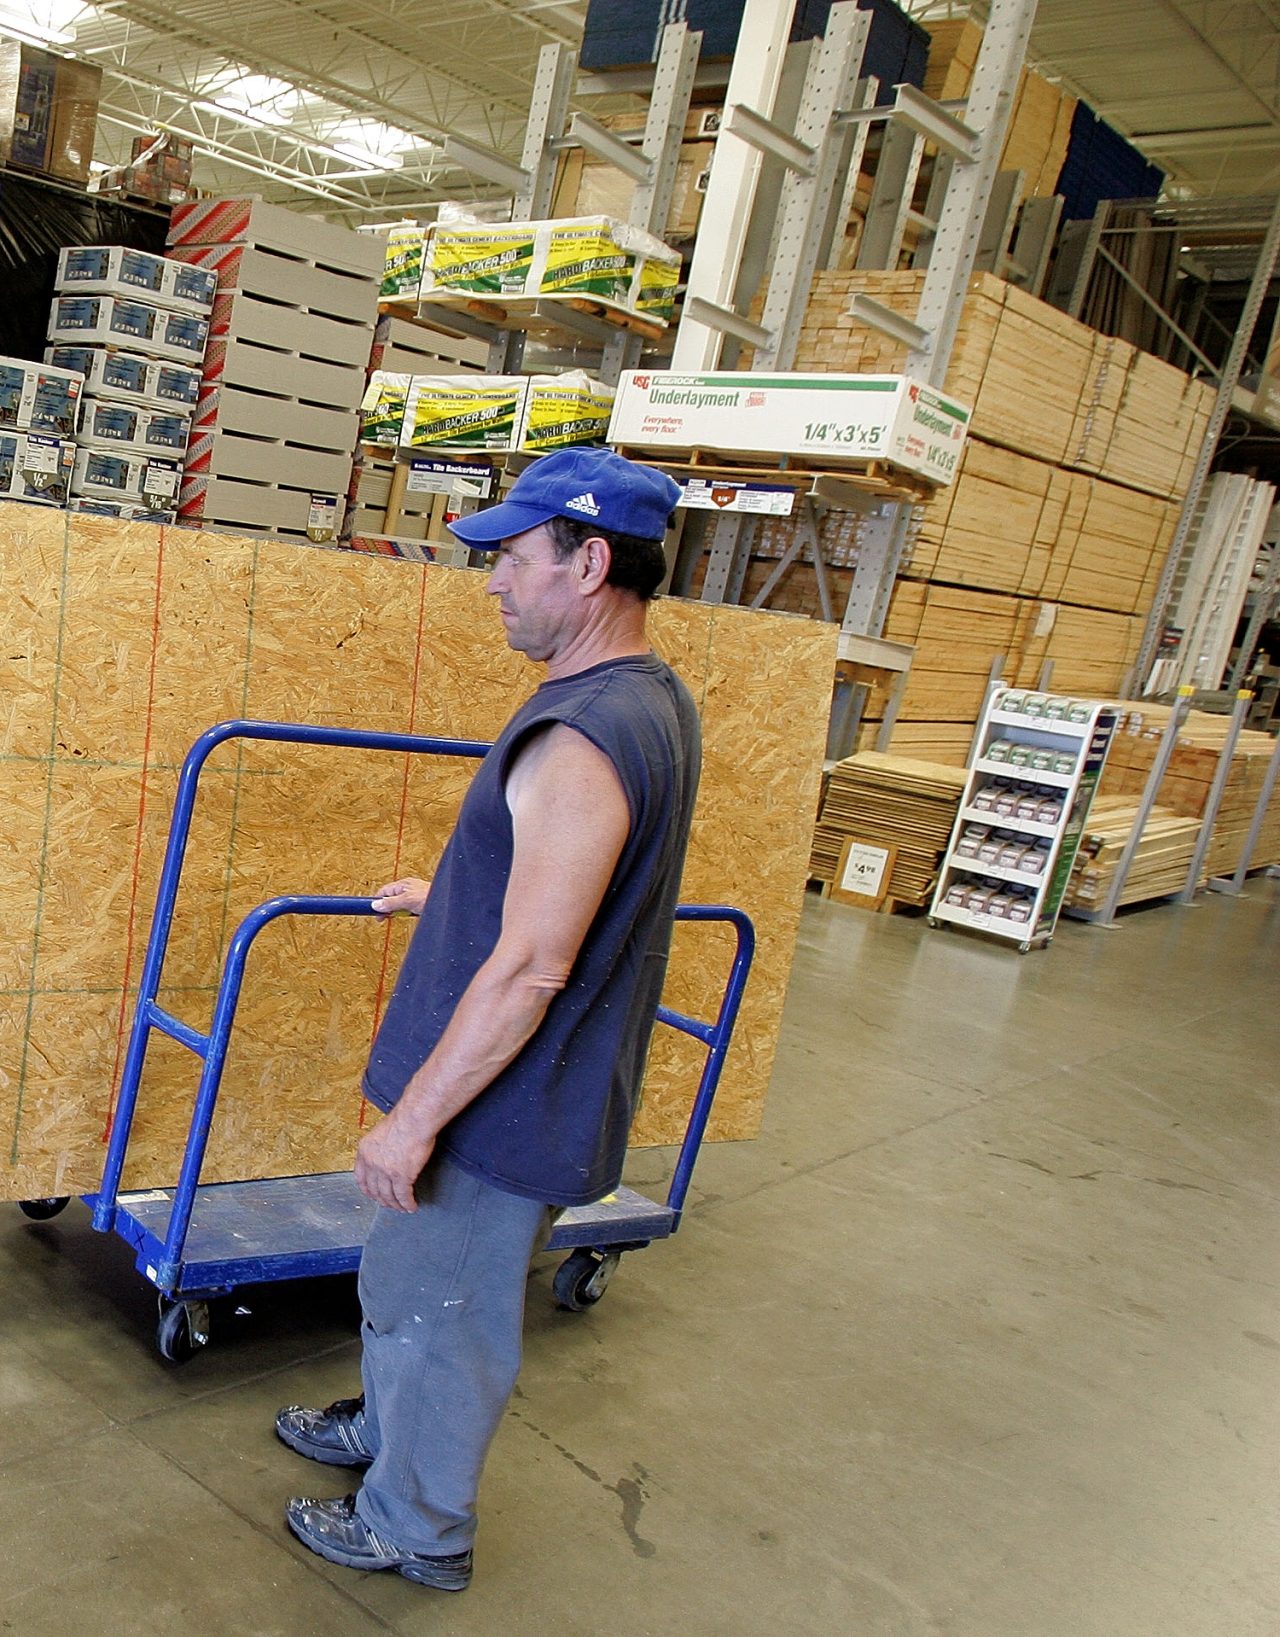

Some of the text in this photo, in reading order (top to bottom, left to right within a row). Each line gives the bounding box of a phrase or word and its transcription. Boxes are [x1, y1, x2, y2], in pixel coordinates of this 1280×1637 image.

[633, 375, 651, 390] USG
[649, 389, 740, 409] Underlayment
[479, 406, 499, 421] 500
[643, 414, 684, 425] Everywhere,
[641, 425, 659, 434] every
[433, 463, 445, 472] Tile
[445, 465, 490, 476] Backerboard
[565, 499, 600, 517] adidas
